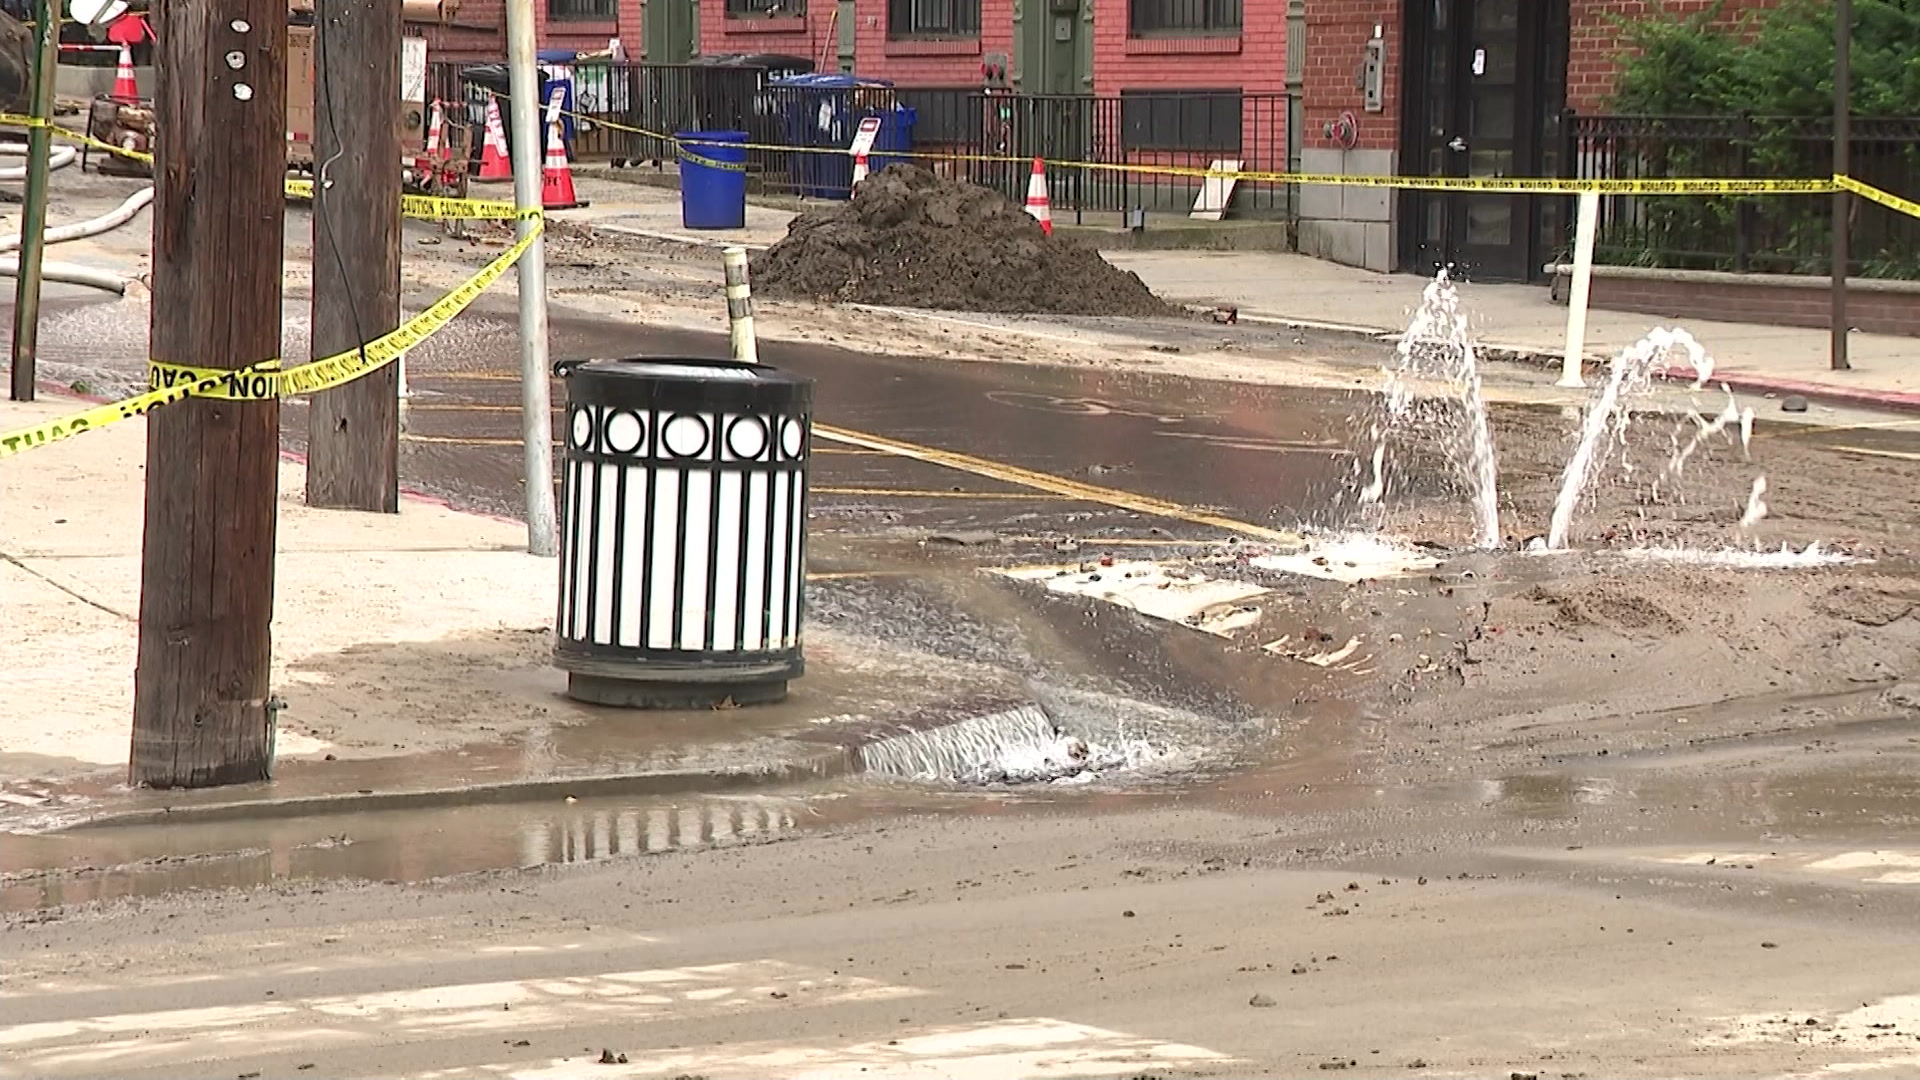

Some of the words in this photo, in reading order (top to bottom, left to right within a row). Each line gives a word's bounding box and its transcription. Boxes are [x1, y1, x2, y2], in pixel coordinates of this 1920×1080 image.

[1559, 181, 1594, 190] CAUTION
[1599, 181, 1634, 191] CAUTION
[1639, 181, 1676, 191] CAUTION
[1683, 181, 1721, 191] CAUTION
[1727, 181, 1766, 191] CAUTION
[401, 198, 434, 215] CAUTION
[440, 200, 475, 217] CAUTION
